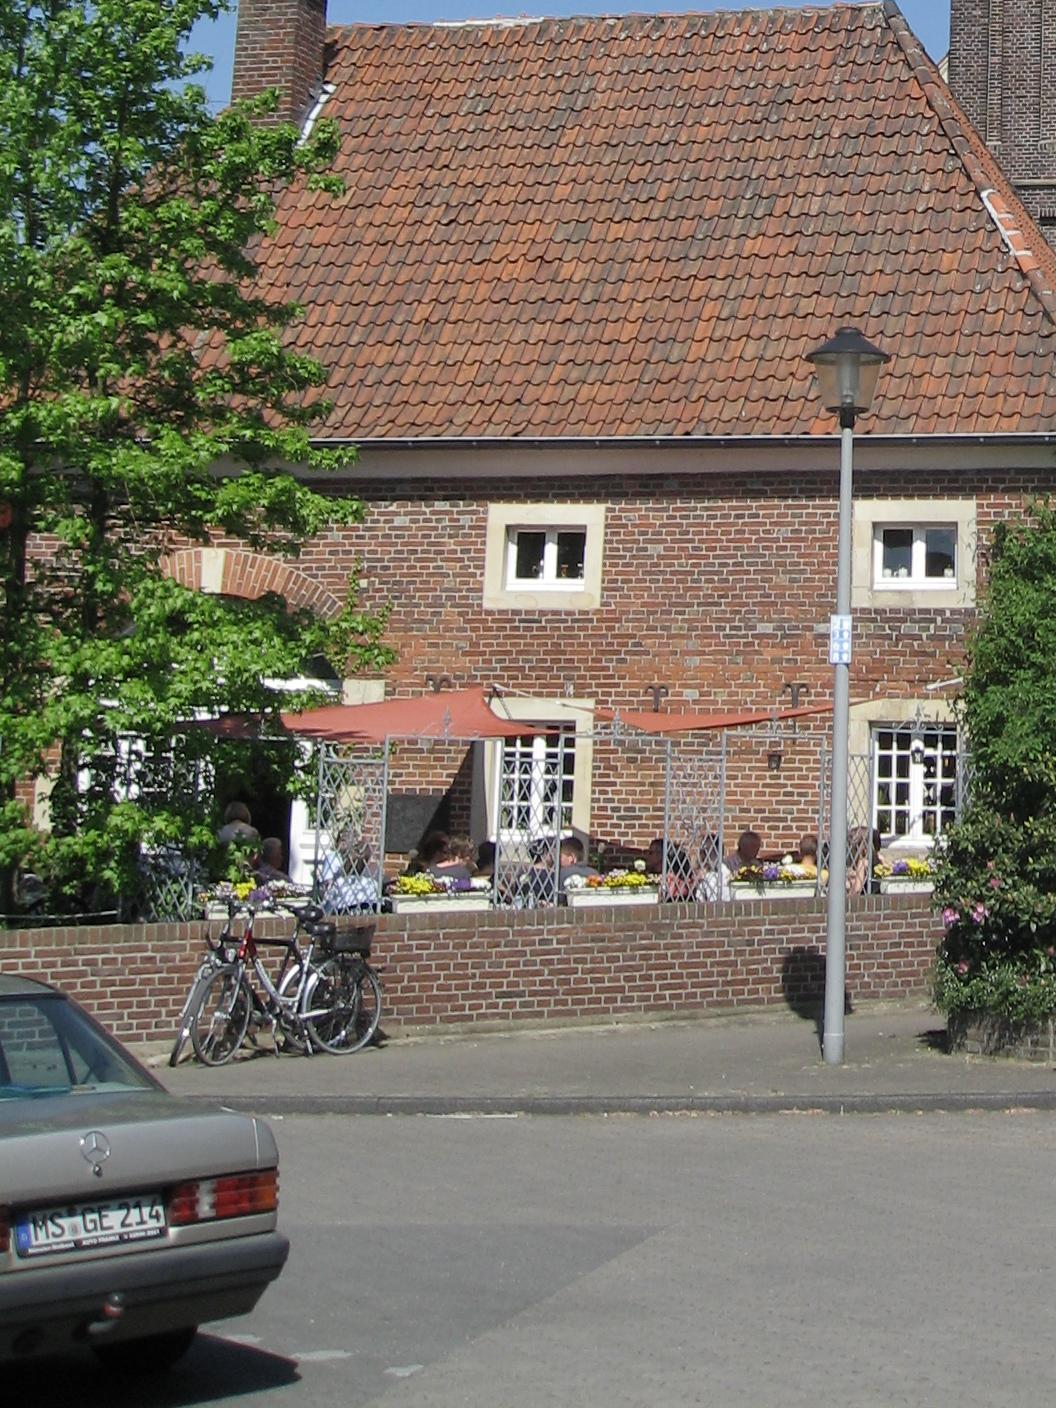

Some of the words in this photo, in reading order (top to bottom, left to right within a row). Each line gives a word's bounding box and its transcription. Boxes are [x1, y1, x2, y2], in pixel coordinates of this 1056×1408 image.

[32, 1212, 65, 1241] MS
[81, 1205, 114, 1234] GE
[119, 1199, 161, 1228] 214
